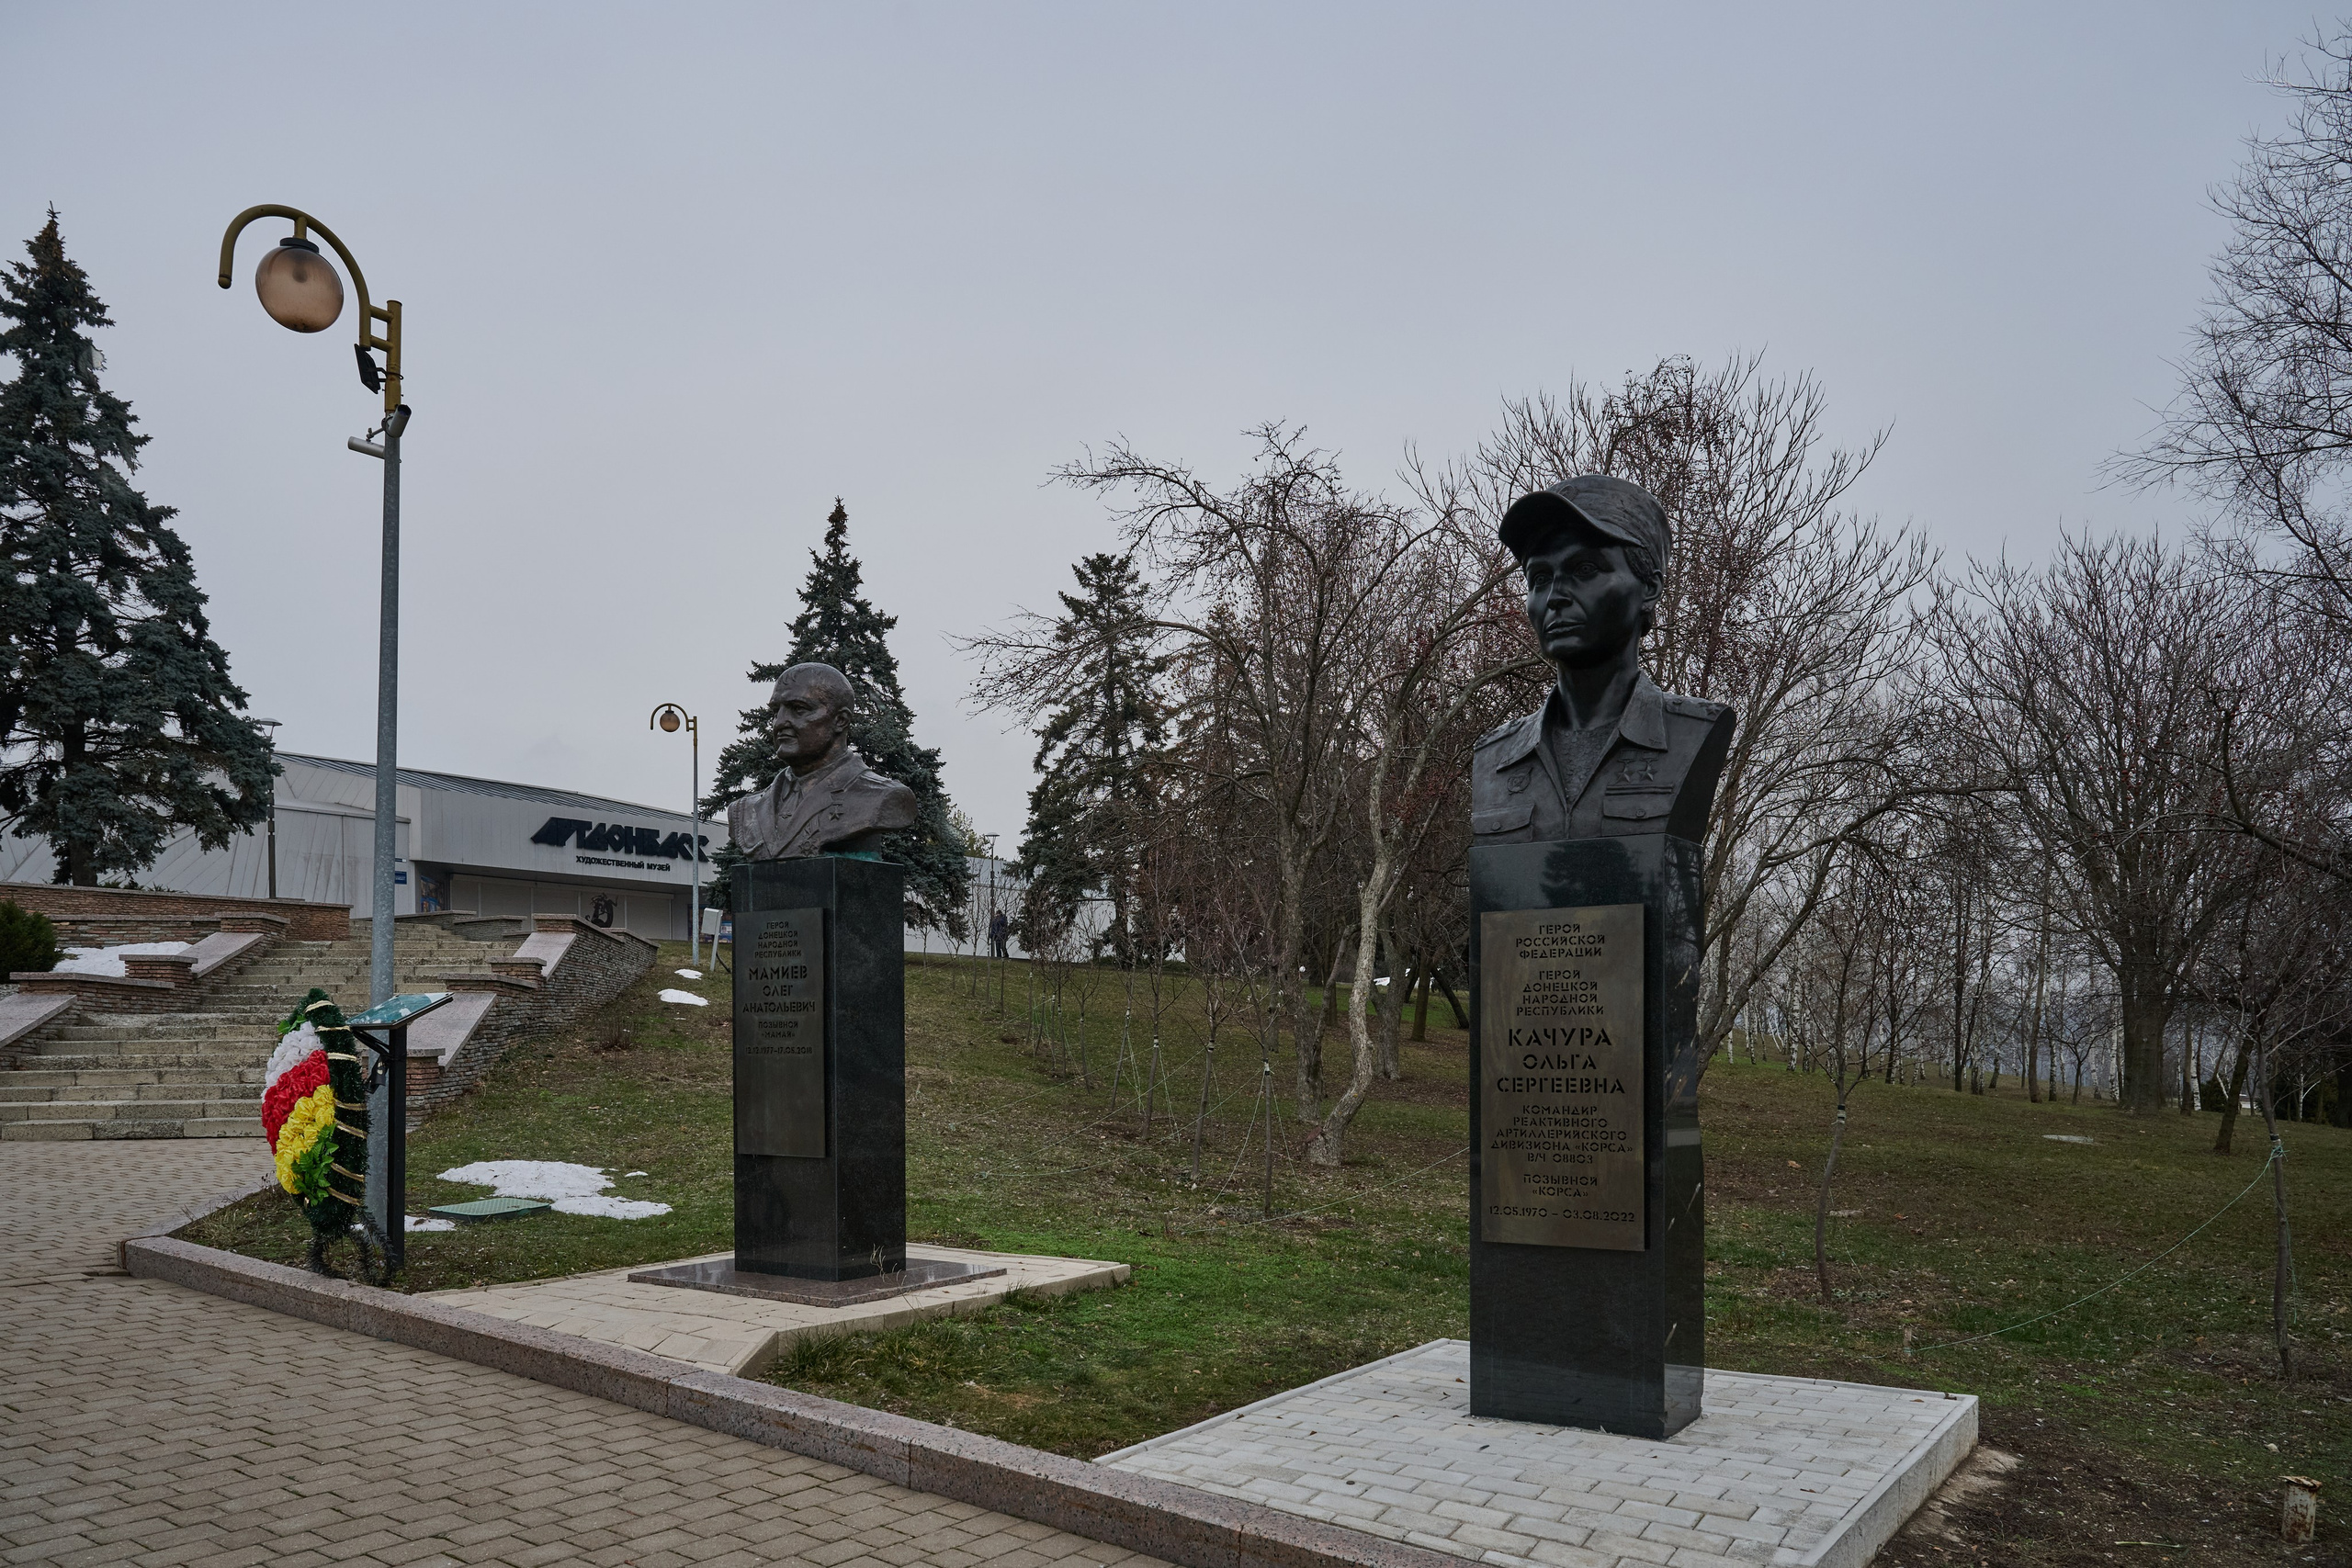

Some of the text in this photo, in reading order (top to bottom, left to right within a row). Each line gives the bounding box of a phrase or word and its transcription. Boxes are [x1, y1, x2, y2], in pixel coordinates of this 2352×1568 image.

[576, 855, 671, 871] ХУДОЖЕСТВЕННЫЙ МУЗЕЙ
[758, 931, 797, 939] ДОНЕЦКОЙ
[1539, 924, 1580, 934] ГЕРОЙ
[758, 940, 797, 949] НАРОДНОЙ
[1516, 934, 1605, 947] РОССИЙСКОЙ
[754, 950, 801, 958] РЕСПУБЛИКИ
[1520, 947, 1601, 959] ФЕДЕРАЦИИ
[749, 965, 808, 980] МАМИЕВ
[1539, 969, 1580, 980] ГЕРОЙ
[763, 985, 793, 996] ОЛЕГ
[1522, 981, 1598, 993] ДОНЕЦКОЙ
[1522, 993, 1597, 1004] НАРОДНОЙ
[742, 1001, 815, 1012] АНАТОЛЬЕВИЧ
[1517, 1005, 1604, 1016] РЕСПУБЛИКИ
[758, 1021, 798, 1029] ПОЗЫВНОЙ
[1509, 1028, 1611, 1046] КАЧУРА
[1522, 1055, 1597, 1069] ОЛЬГА
[1497, 1077, 1625, 1094] СЕРГЕЕВНА
[1522, 1105, 1598, 1115] КОМАНДИР
[1513, 1116, 1608, 1128] РЕАКТИВНОГО
[1496, 1129, 1627, 1141] АРТИЛЛЕРИЙСКОГО
[1490, 1140, 1633, 1153] ДИВИЗИОНА «КОРСА»
[1527, 1153, 1593, 1164] В/Ч 08803
[1523, 1174, 1598, 1186] ПОЗЫВНОЙ
[1532, 1186, 1589, 1198] «КОРСА»
[1489, 1205, 1548, 1218] 12.05.1970
[1563, 1209, 1635, 1223] 03.08.2022
